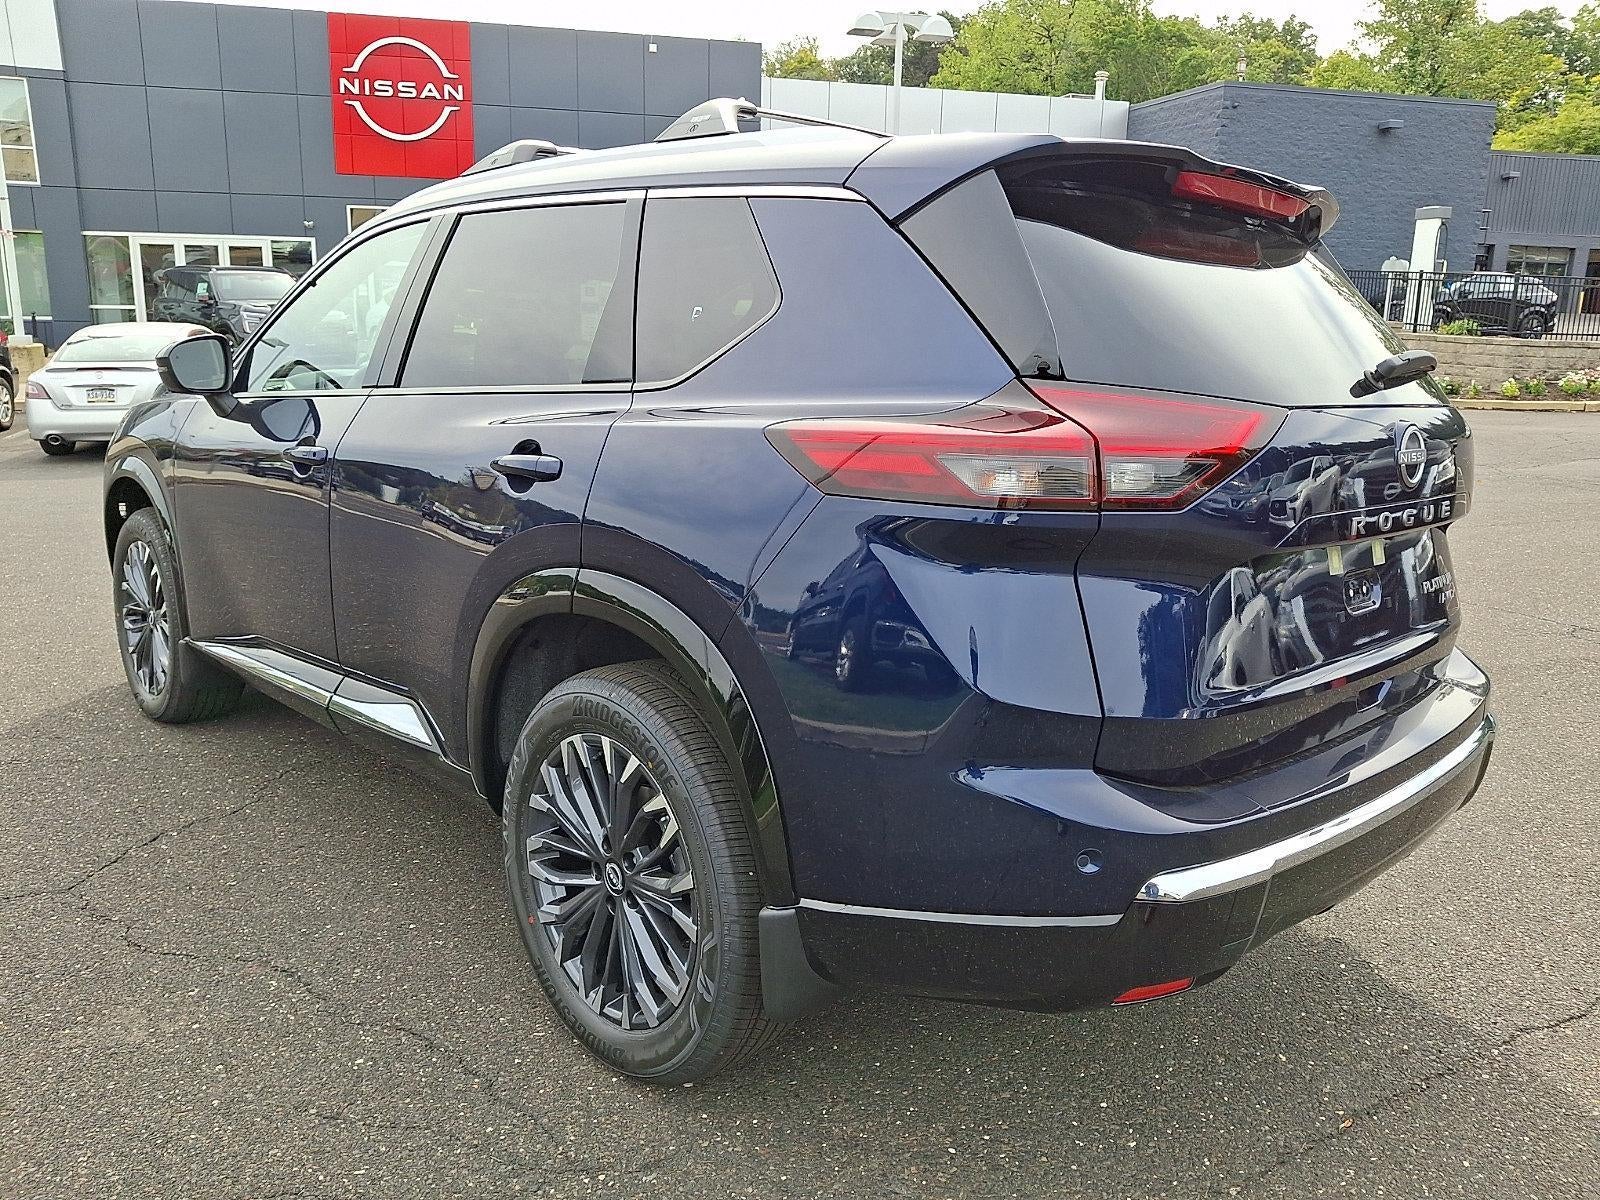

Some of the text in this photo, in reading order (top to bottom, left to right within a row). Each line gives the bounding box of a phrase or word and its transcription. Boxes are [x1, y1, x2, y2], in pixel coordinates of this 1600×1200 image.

[339, 77, 464, 101] NISSAN
[1400, 452, 1425, 462] NISS
[1350, 500, 1451, 536] ROGUE
[572, 695, 679, 792] BRIDGESTONE
